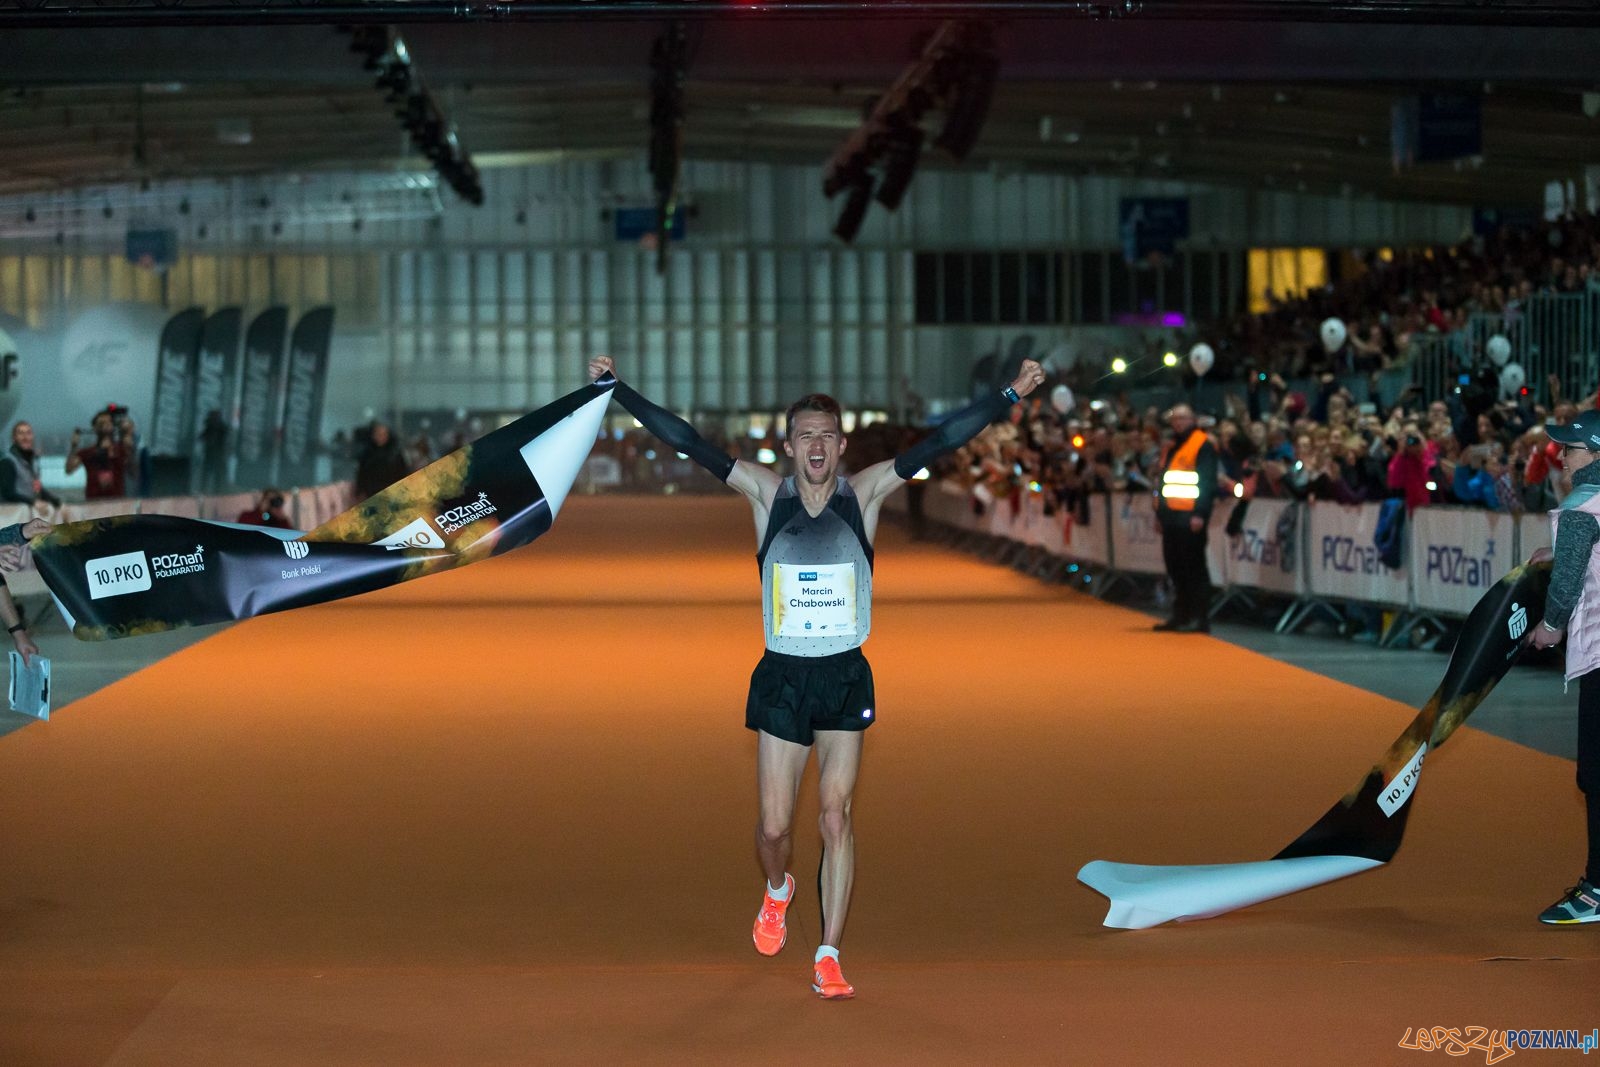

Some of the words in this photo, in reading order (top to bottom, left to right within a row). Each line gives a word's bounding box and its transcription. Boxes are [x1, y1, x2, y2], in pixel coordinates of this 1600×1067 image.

[0, 353, 18, 391] F
[281, 568, 300, 580] Bank
[300, 564, 322, 576] Polski
[802, 587, 833, 596] Marcin
[789, 597, 845, 608] Chabowski
